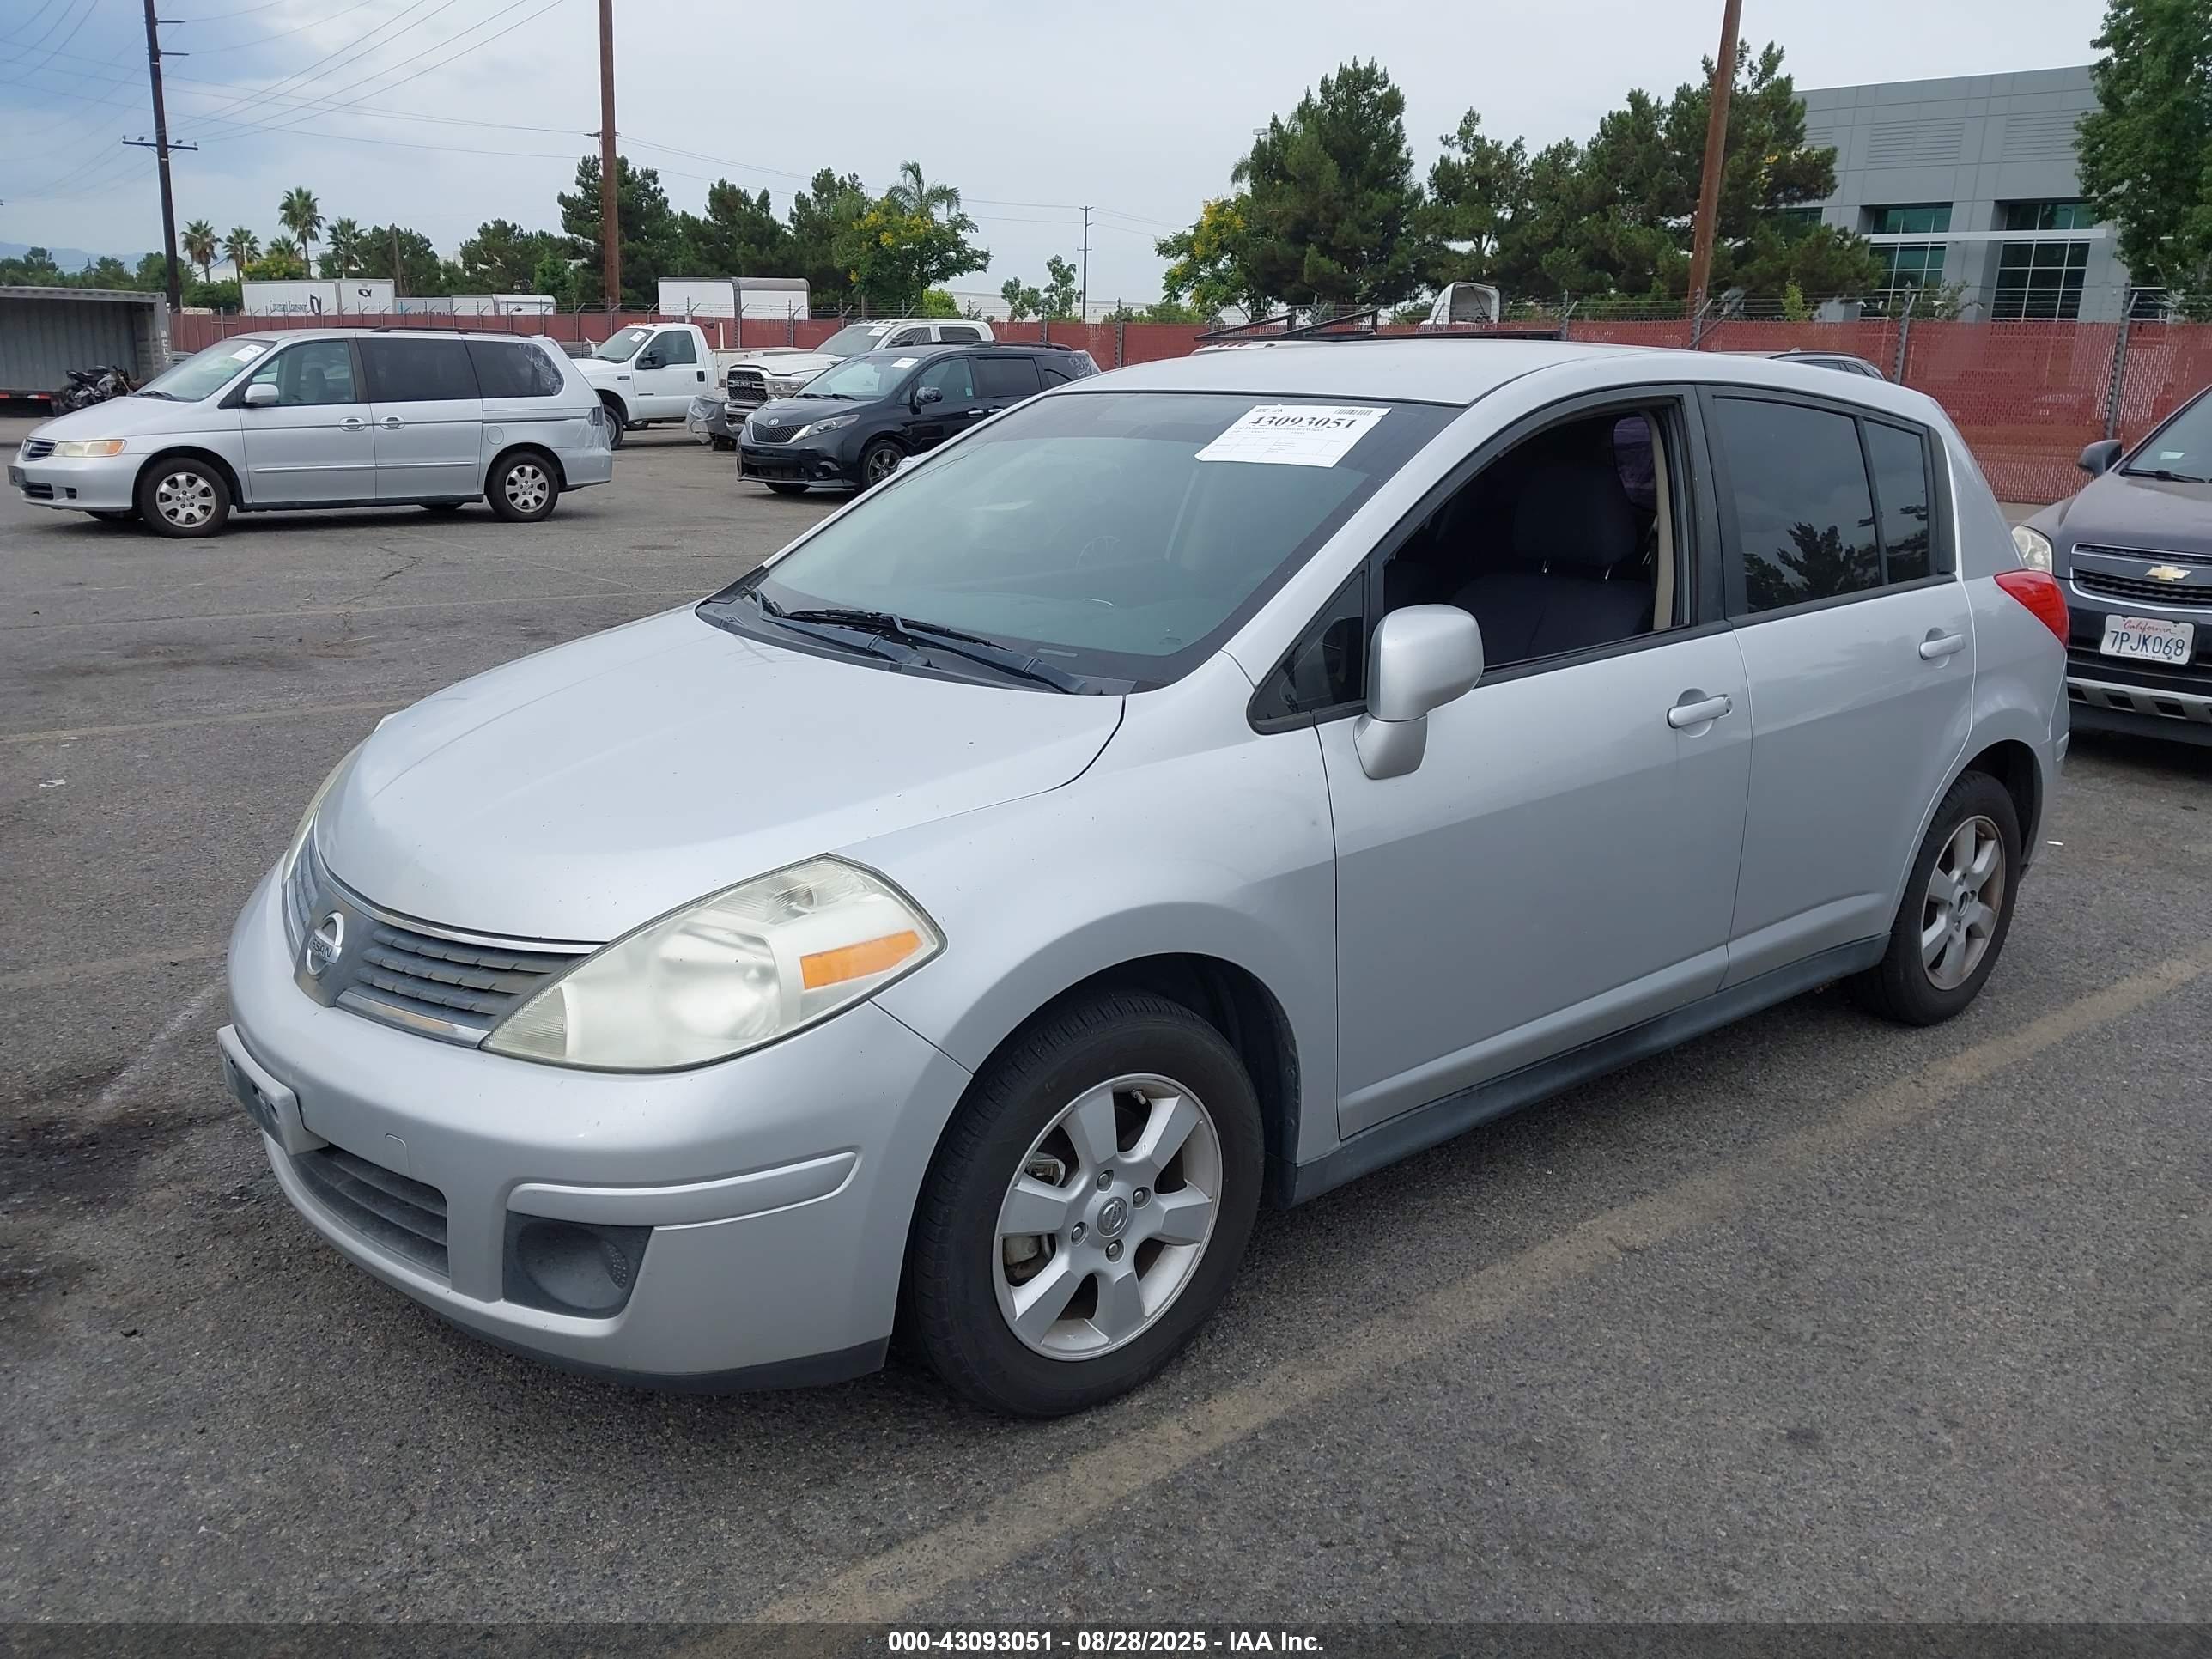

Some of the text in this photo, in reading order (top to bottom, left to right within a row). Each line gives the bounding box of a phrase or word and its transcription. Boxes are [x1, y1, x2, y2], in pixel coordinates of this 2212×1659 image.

[1248, 416, 1358, 429] 43093051
[2123, 619, 2177, 635] California
[2110, 630, 2185, 657] 7PJK068
[310, 937, 334, 960] SSAN
